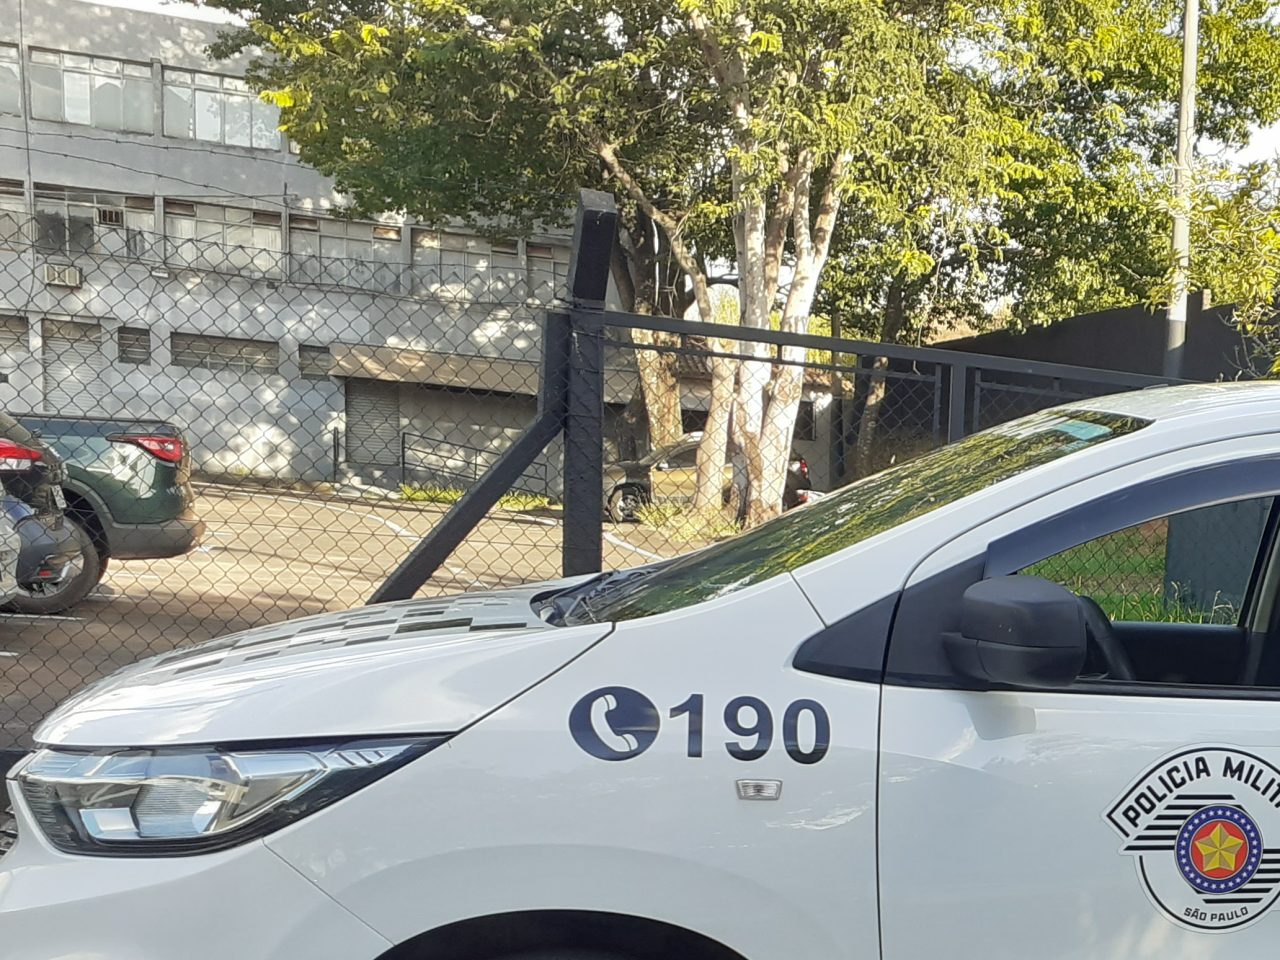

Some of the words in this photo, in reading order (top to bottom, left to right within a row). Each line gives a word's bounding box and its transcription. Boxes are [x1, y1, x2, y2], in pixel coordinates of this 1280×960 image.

[669, 693, 831, 765] 190
[1121, 756, 1211, 829] POLICIA
[1183, 907, 1207, 921] SÃO
[1210, 906, 1249, 922] PAULO
